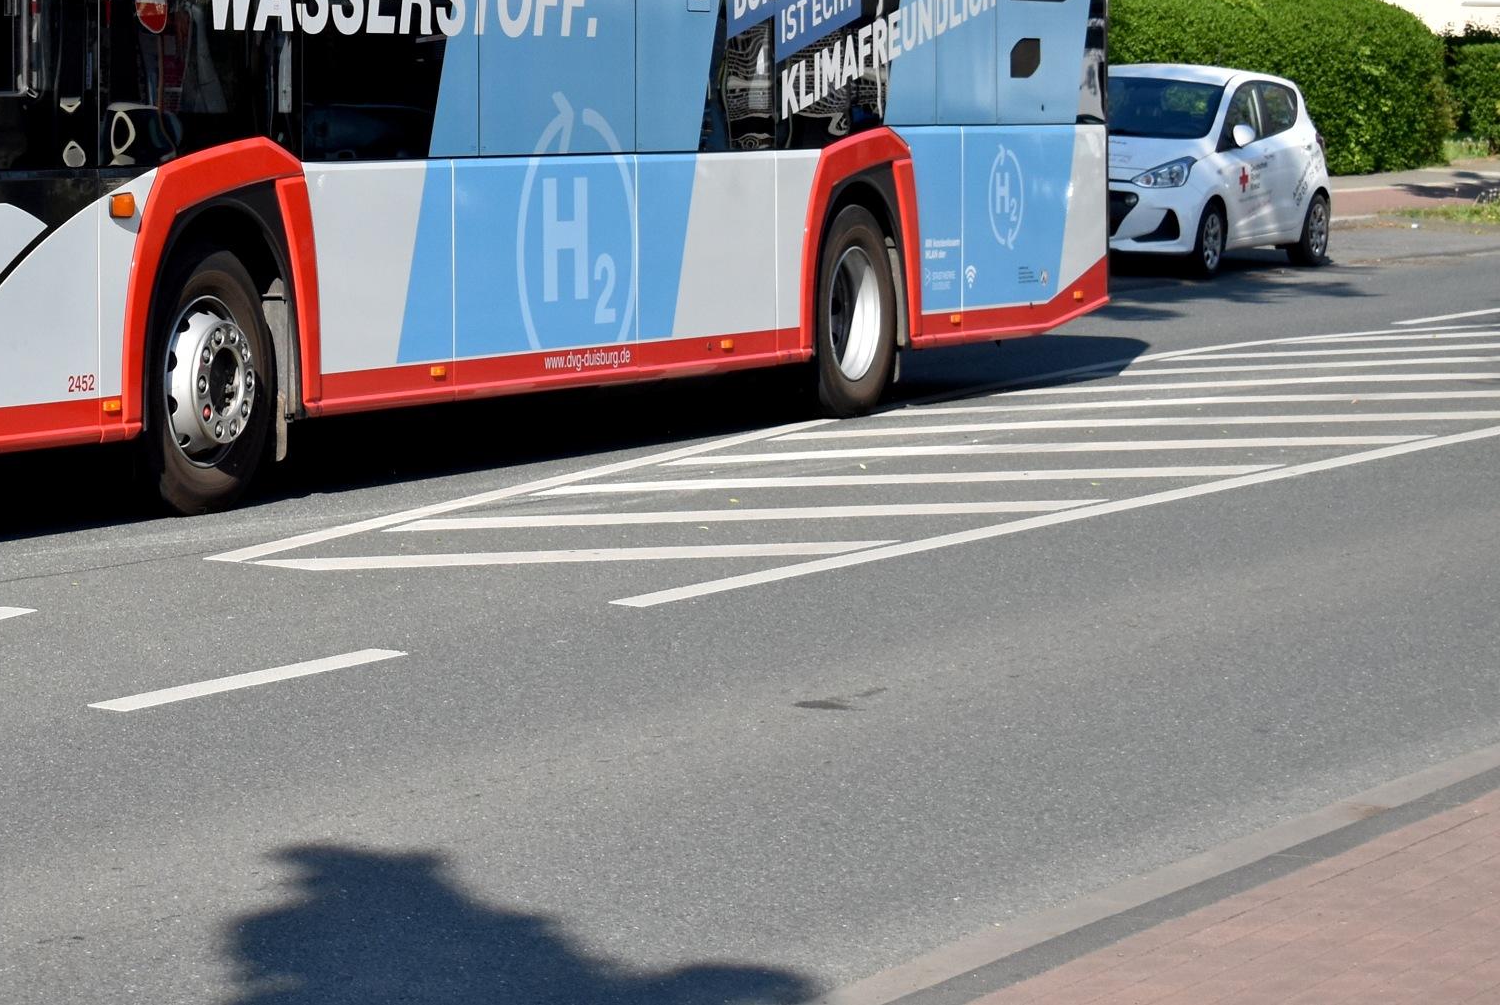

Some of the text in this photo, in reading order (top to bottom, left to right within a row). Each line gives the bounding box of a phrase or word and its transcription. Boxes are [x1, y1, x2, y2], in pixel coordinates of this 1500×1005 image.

[543, 177, 617, 325] H2
[544, 347, 631, 372] www.dvg-duisburg.de
[68, 374, 95, 393] 2452
